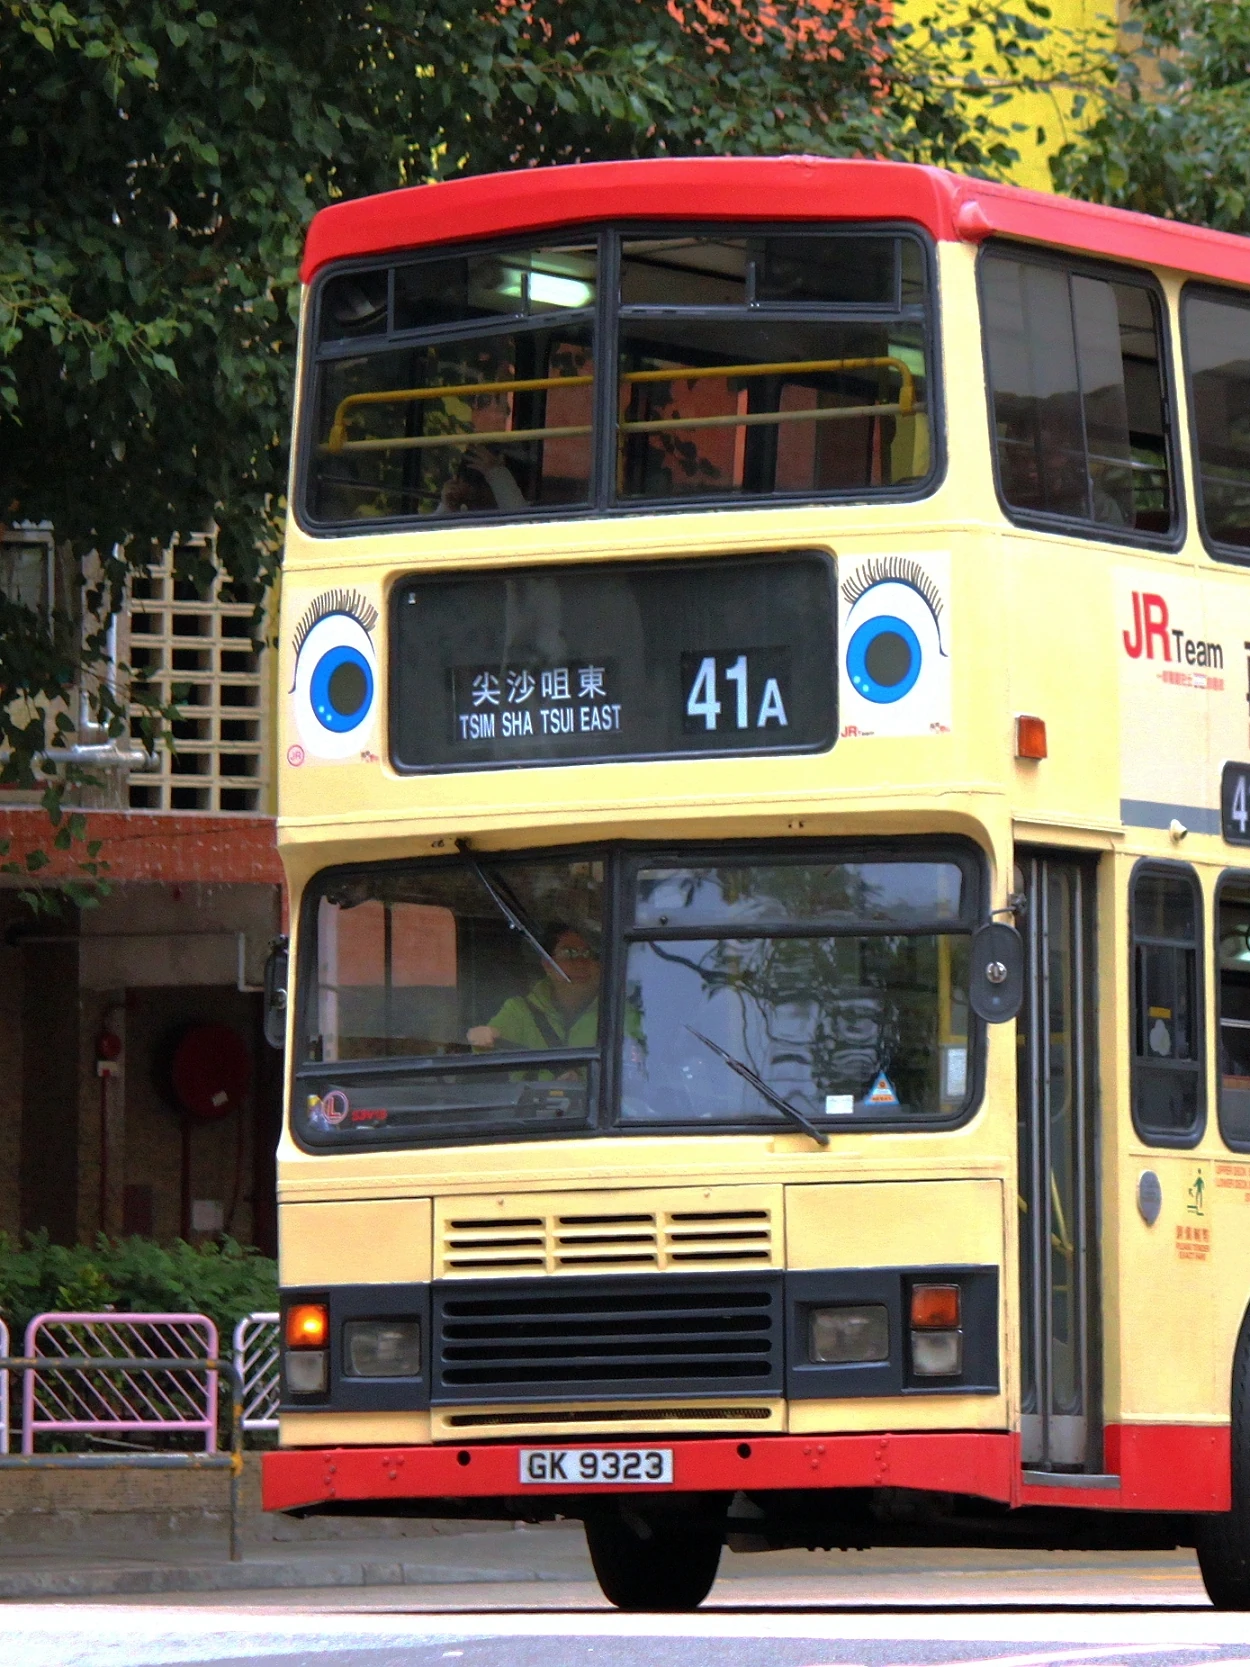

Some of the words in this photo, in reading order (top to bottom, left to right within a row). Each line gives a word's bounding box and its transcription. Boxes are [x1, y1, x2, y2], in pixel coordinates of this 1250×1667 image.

[1122, 590, 1172, 662] JR
[1171, 629, 1223, 669] Team
[472, 664, 606, 707] 尖沙咀東
[686, 655, 789, 731] 41A
[459, 713, 495, 740] TSIM
[502, 710, 534, 737] SHA
[540, 707, 575, 734] TSUI
[580, 704, 622, 731] EAST
[528, 1452, 567, 1479] GK
[580, 1452, 663, 1479] 9323
